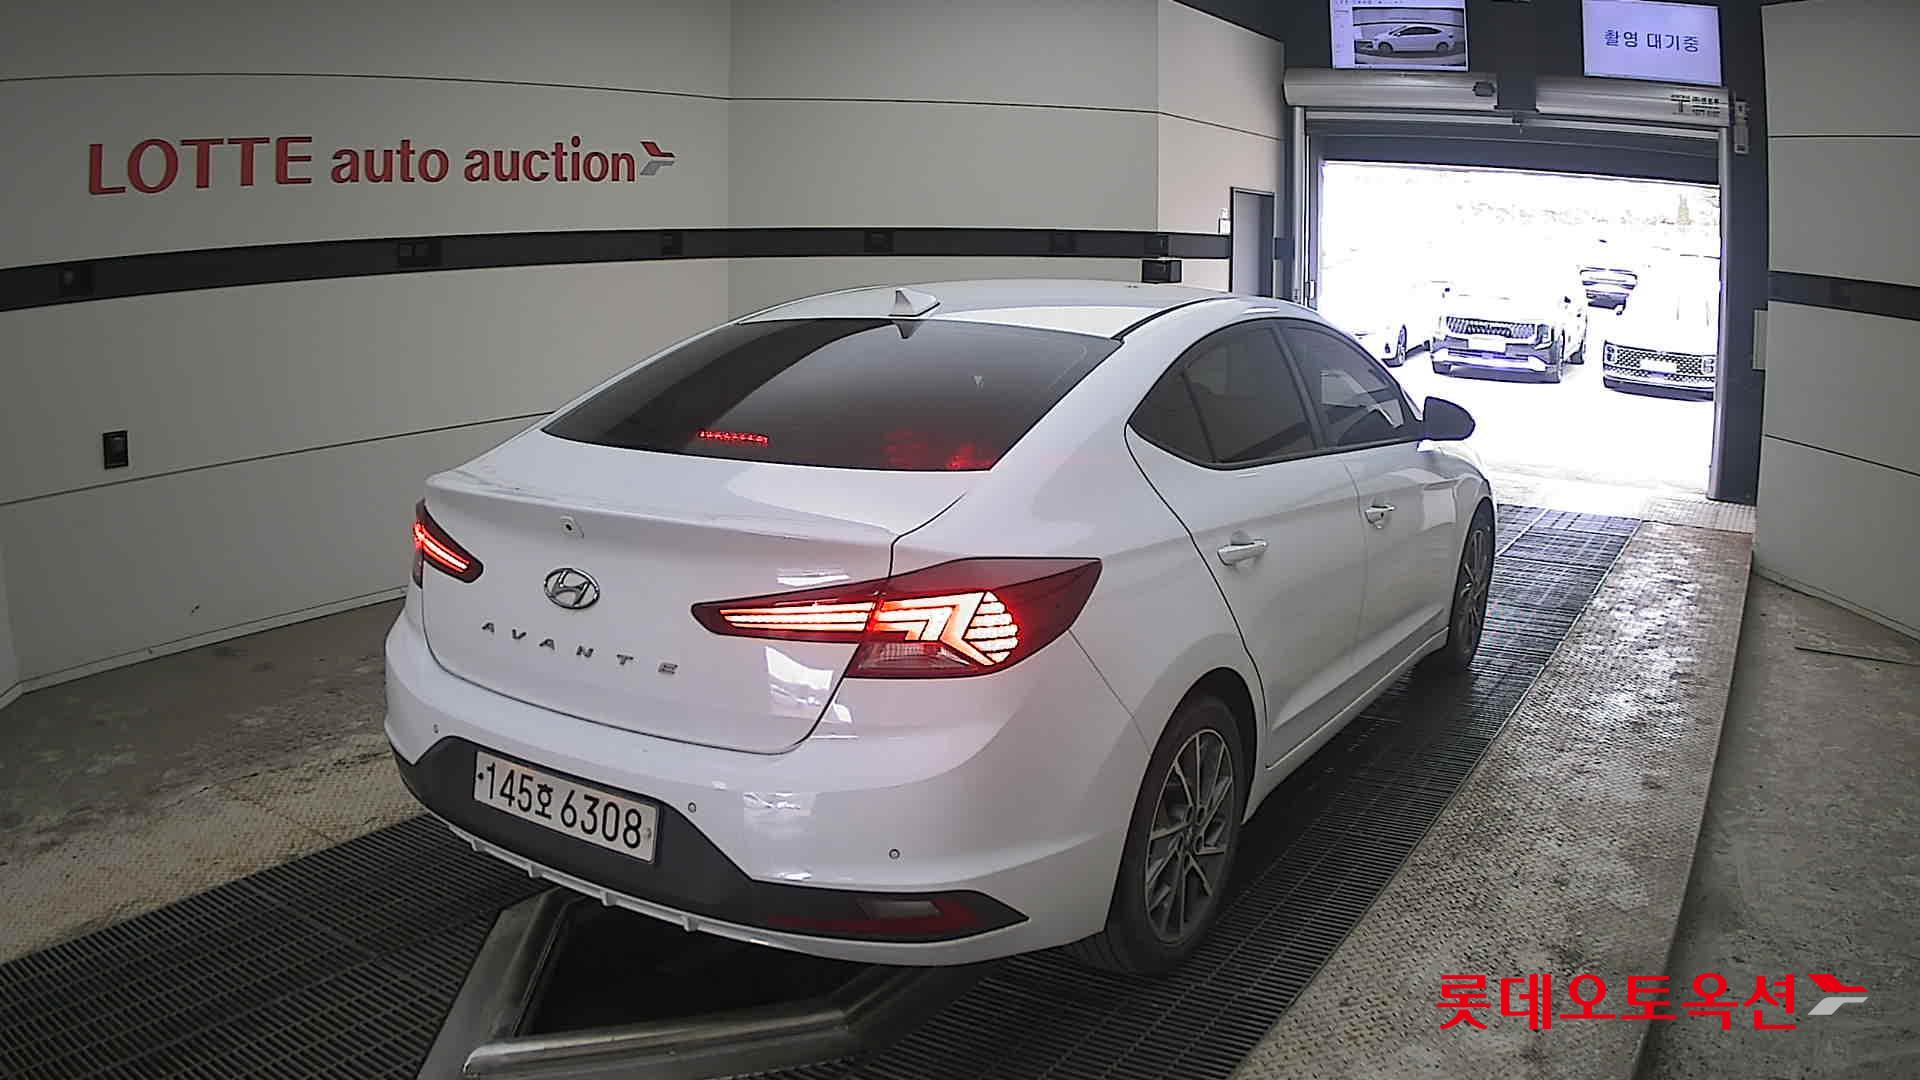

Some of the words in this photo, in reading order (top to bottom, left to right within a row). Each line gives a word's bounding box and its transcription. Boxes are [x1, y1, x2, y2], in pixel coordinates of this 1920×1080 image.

[1604, 29, 1639, 48] 촬영
[1646, 33, 1700, 53] 대기중
[88, 136, 313, 195] LOTTE
[330, 138, 450, 183] auto
[463, 135, 637, 183] auction
[481, 621, 679, 675] AVANTE
[486, 761, 554, 820] 145호
[560, 789, 643, 850] 6308
